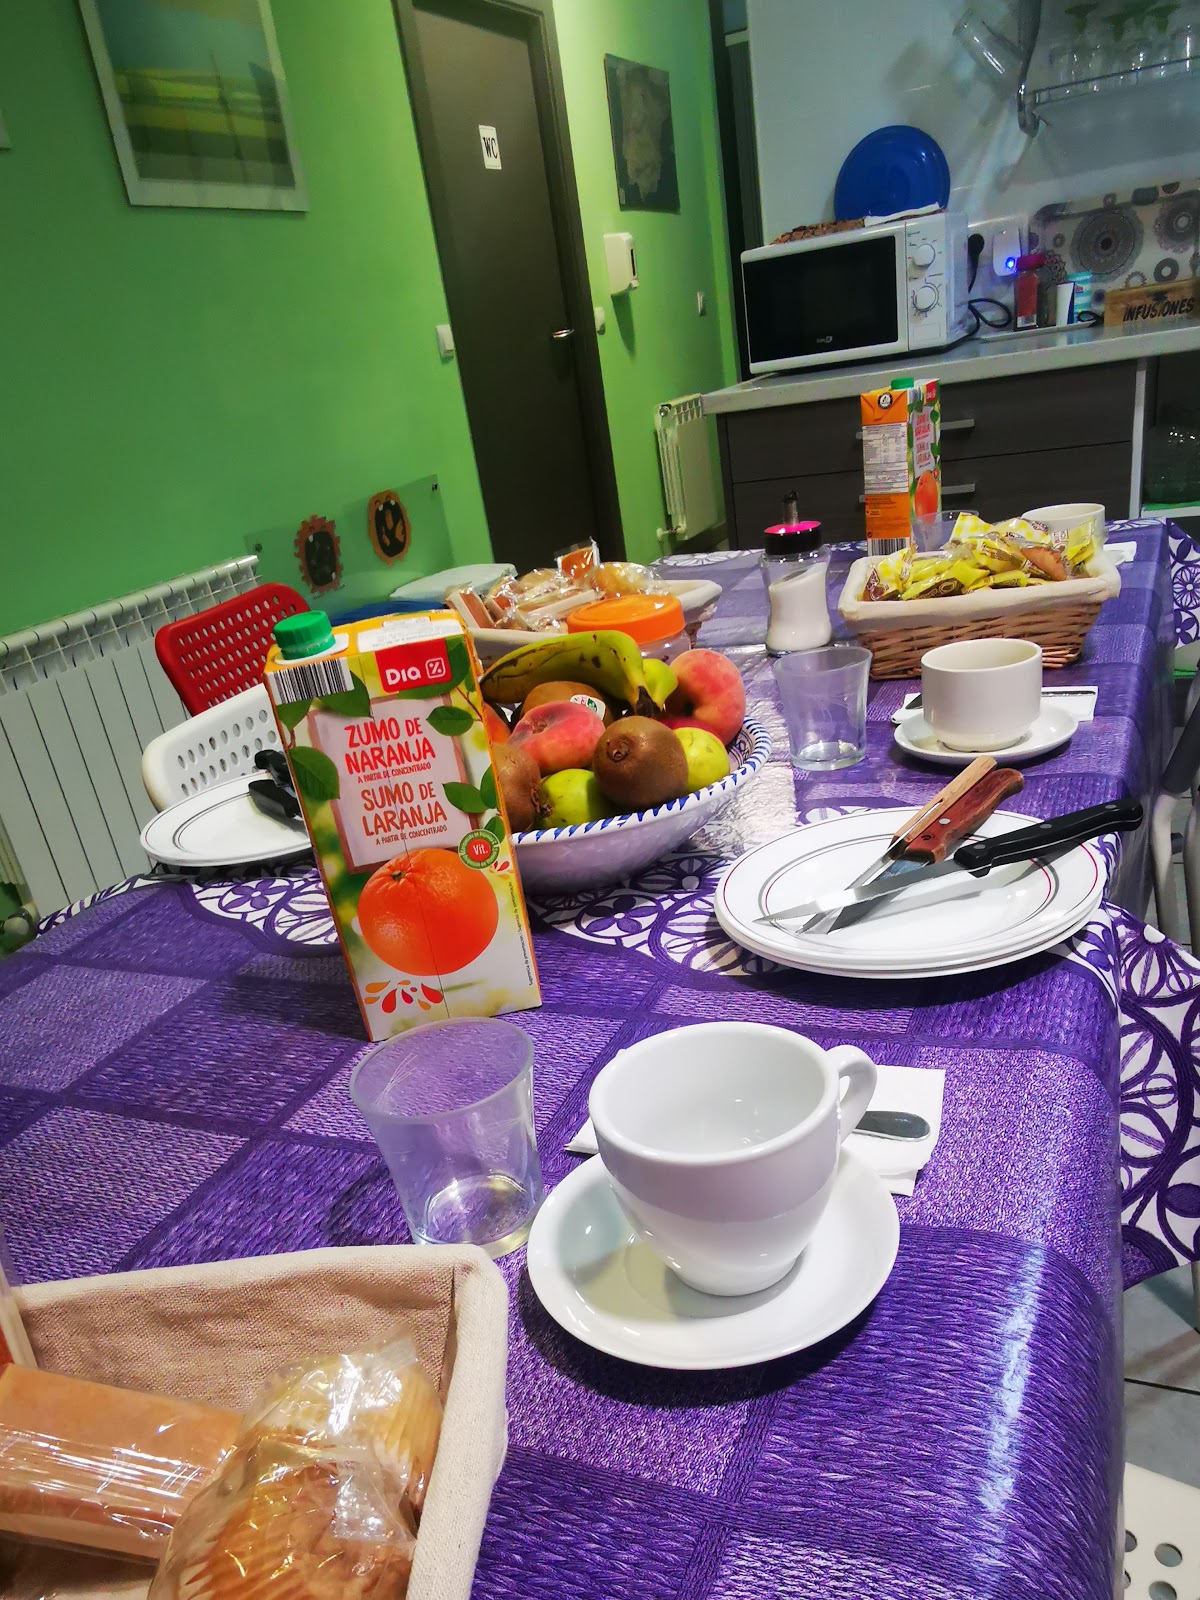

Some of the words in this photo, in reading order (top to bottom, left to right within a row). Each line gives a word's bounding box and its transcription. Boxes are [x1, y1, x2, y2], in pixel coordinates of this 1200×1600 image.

[483, 137, 498, 159] WC
[1123, 298, 1195, 322] INFUSIONES
[344, 717, 401, 749] ZUMO
[405, 718, 423, 738] DE
[345, 737, 436, 775] NARANJA
[357, 776, 363, 784] A
[363, 771, 383, 783] PARTIR
[383, 769, 390, 778] DE
[391, 762, 432, 777] CONCENTRADO
[361, 781, 414, 811] SUMO
[419, 782, 436, 800] DE
[362, 801, 448, 836] LARANJA
[382, 834, 400, 844] PARTIR
[400, 832, 407, 840] DE
[408, 825, 448, 839] CONCENTRADO
[472, 844, 488, 856] Vit.
